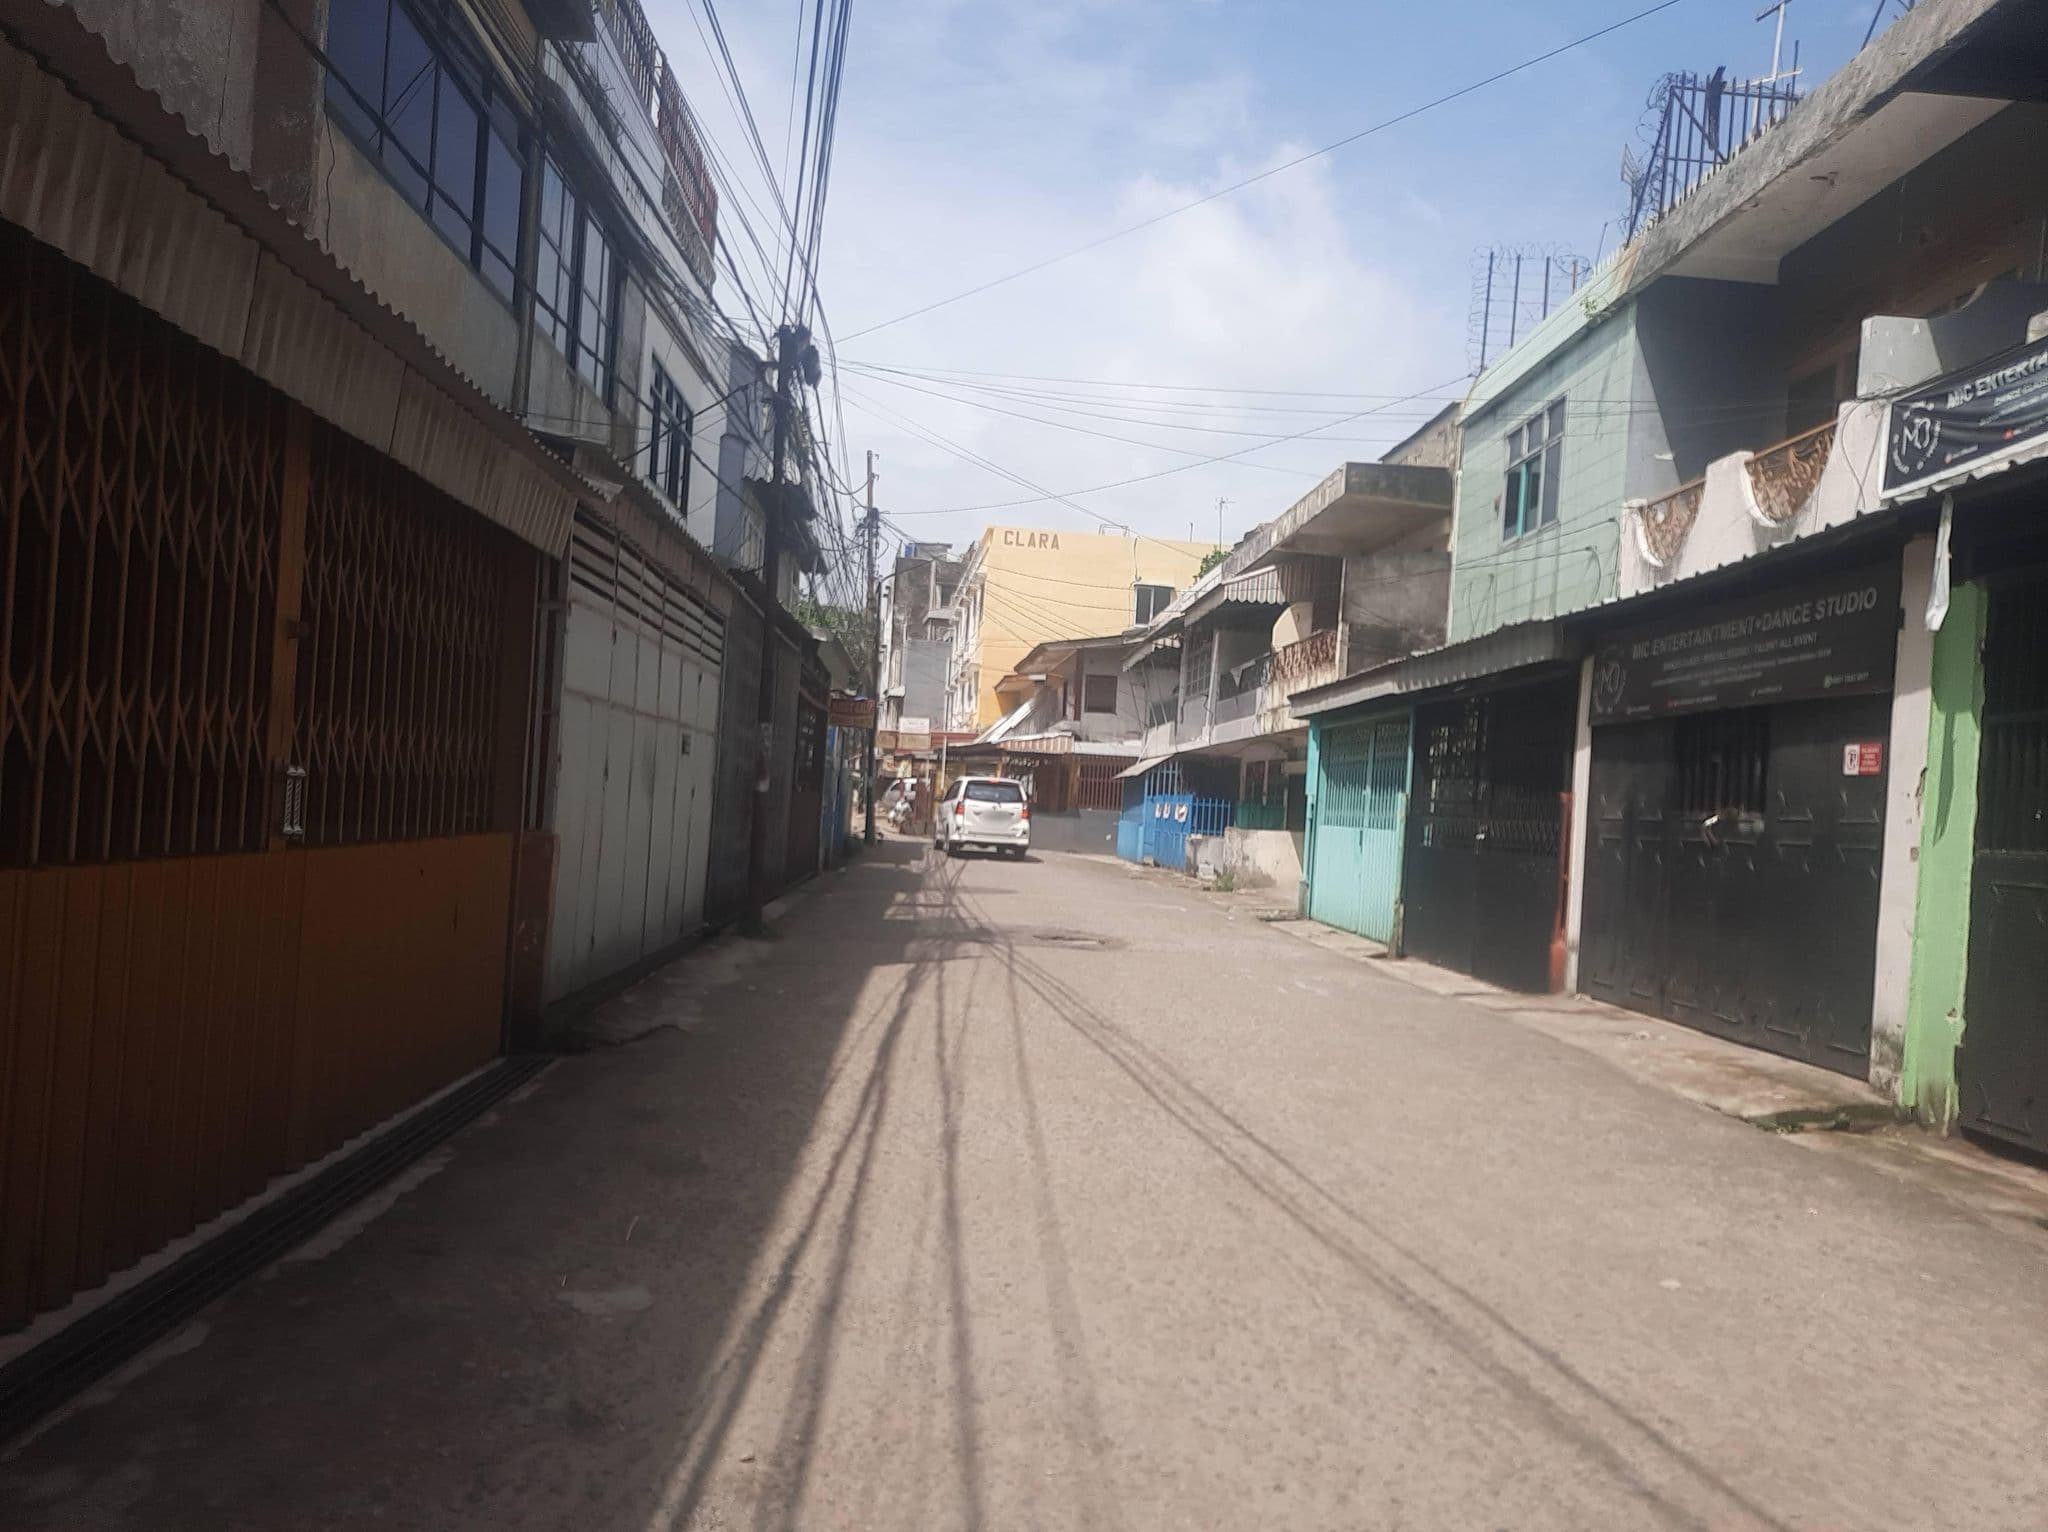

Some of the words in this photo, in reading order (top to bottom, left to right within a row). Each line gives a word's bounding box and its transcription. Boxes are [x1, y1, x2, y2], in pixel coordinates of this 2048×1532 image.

[1004, 530, 1059, 550] CLARA
[1761, 602, 1812, 632] DANCE
[1815, 587, 1878, 620] STUDIO
